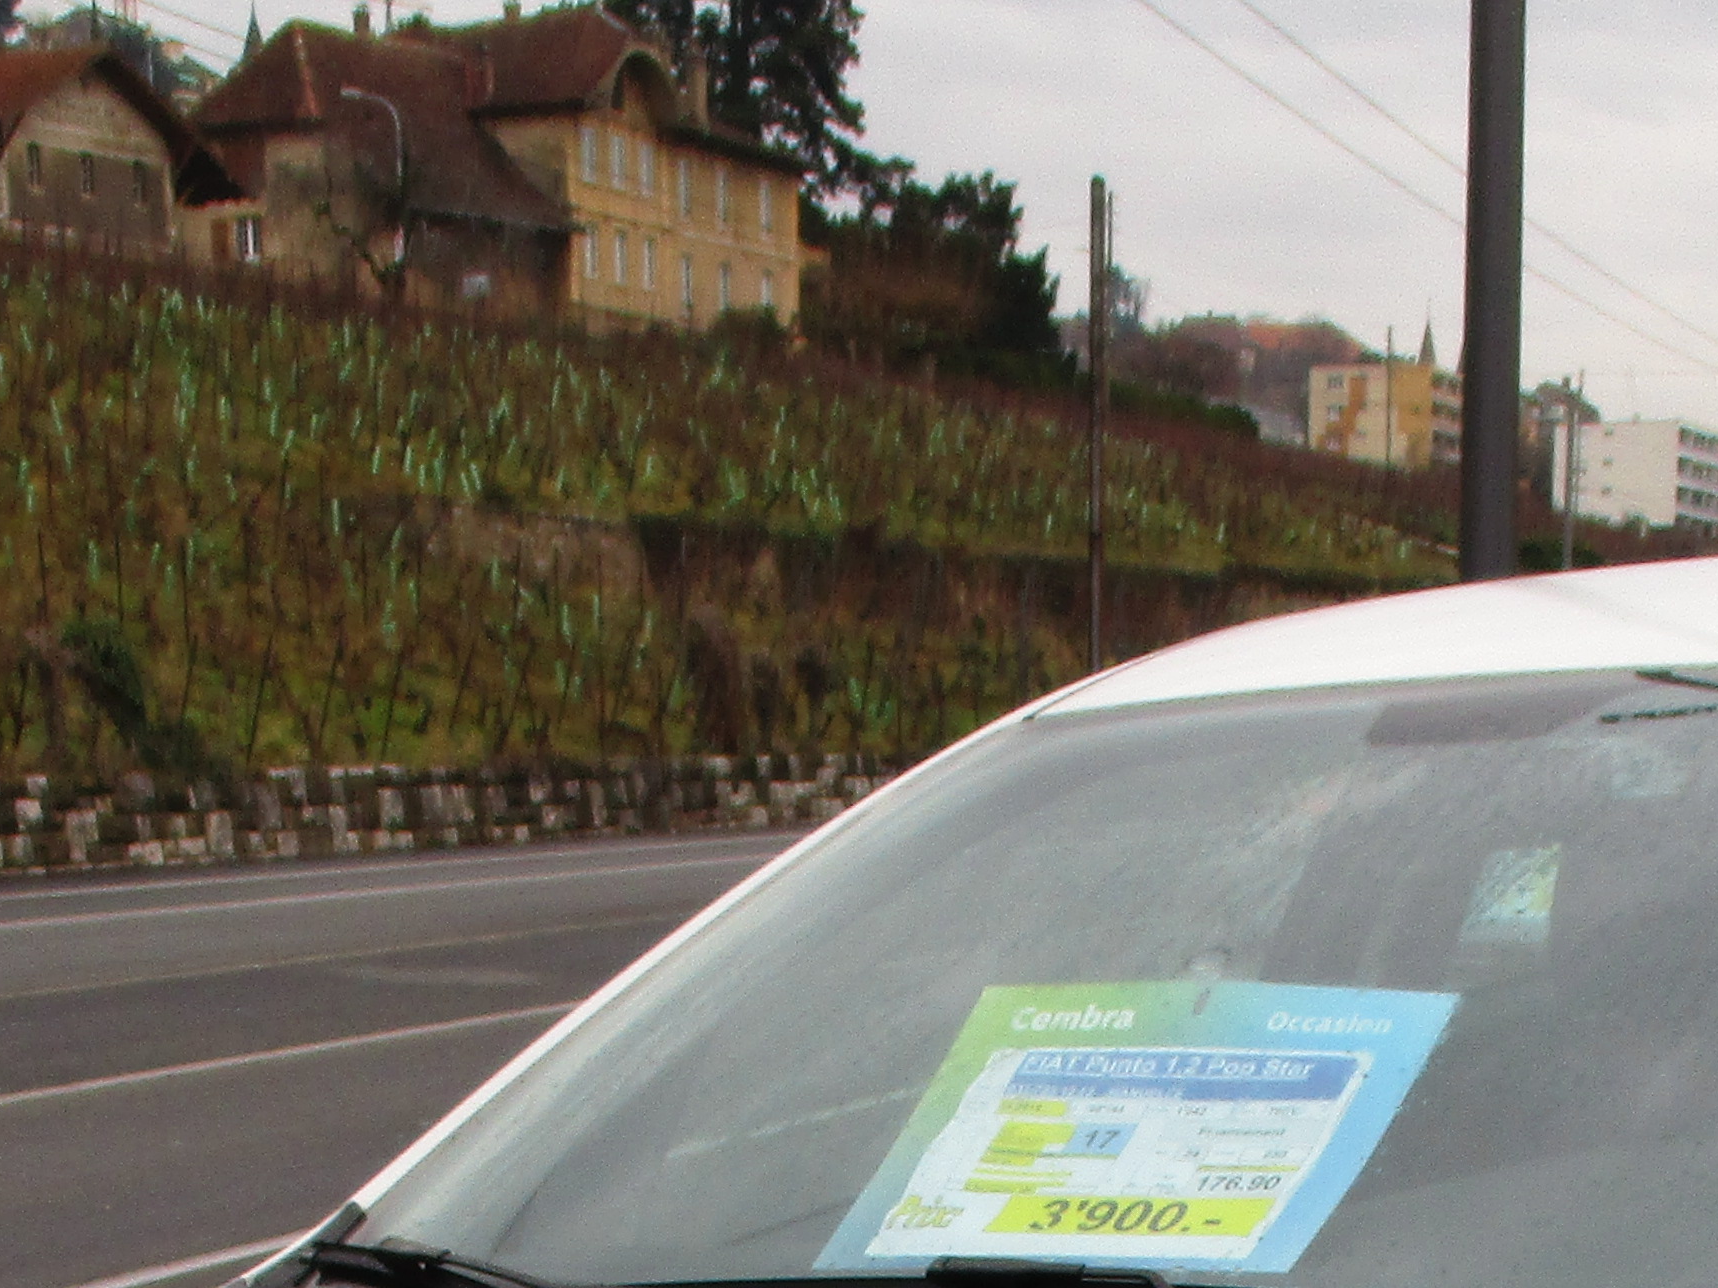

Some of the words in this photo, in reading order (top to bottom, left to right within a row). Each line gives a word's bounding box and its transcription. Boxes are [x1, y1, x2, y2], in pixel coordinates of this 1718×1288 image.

[1266, 1010, 1393, 1033] Occasion
[1083, 1055, 1156, 1075] Punto
[1083, 1129, 1121, 1150] 17
[1197, 1175, 1281, 1191] 176.90
[1030, 1199, 1221, 1233] 3'900.-
